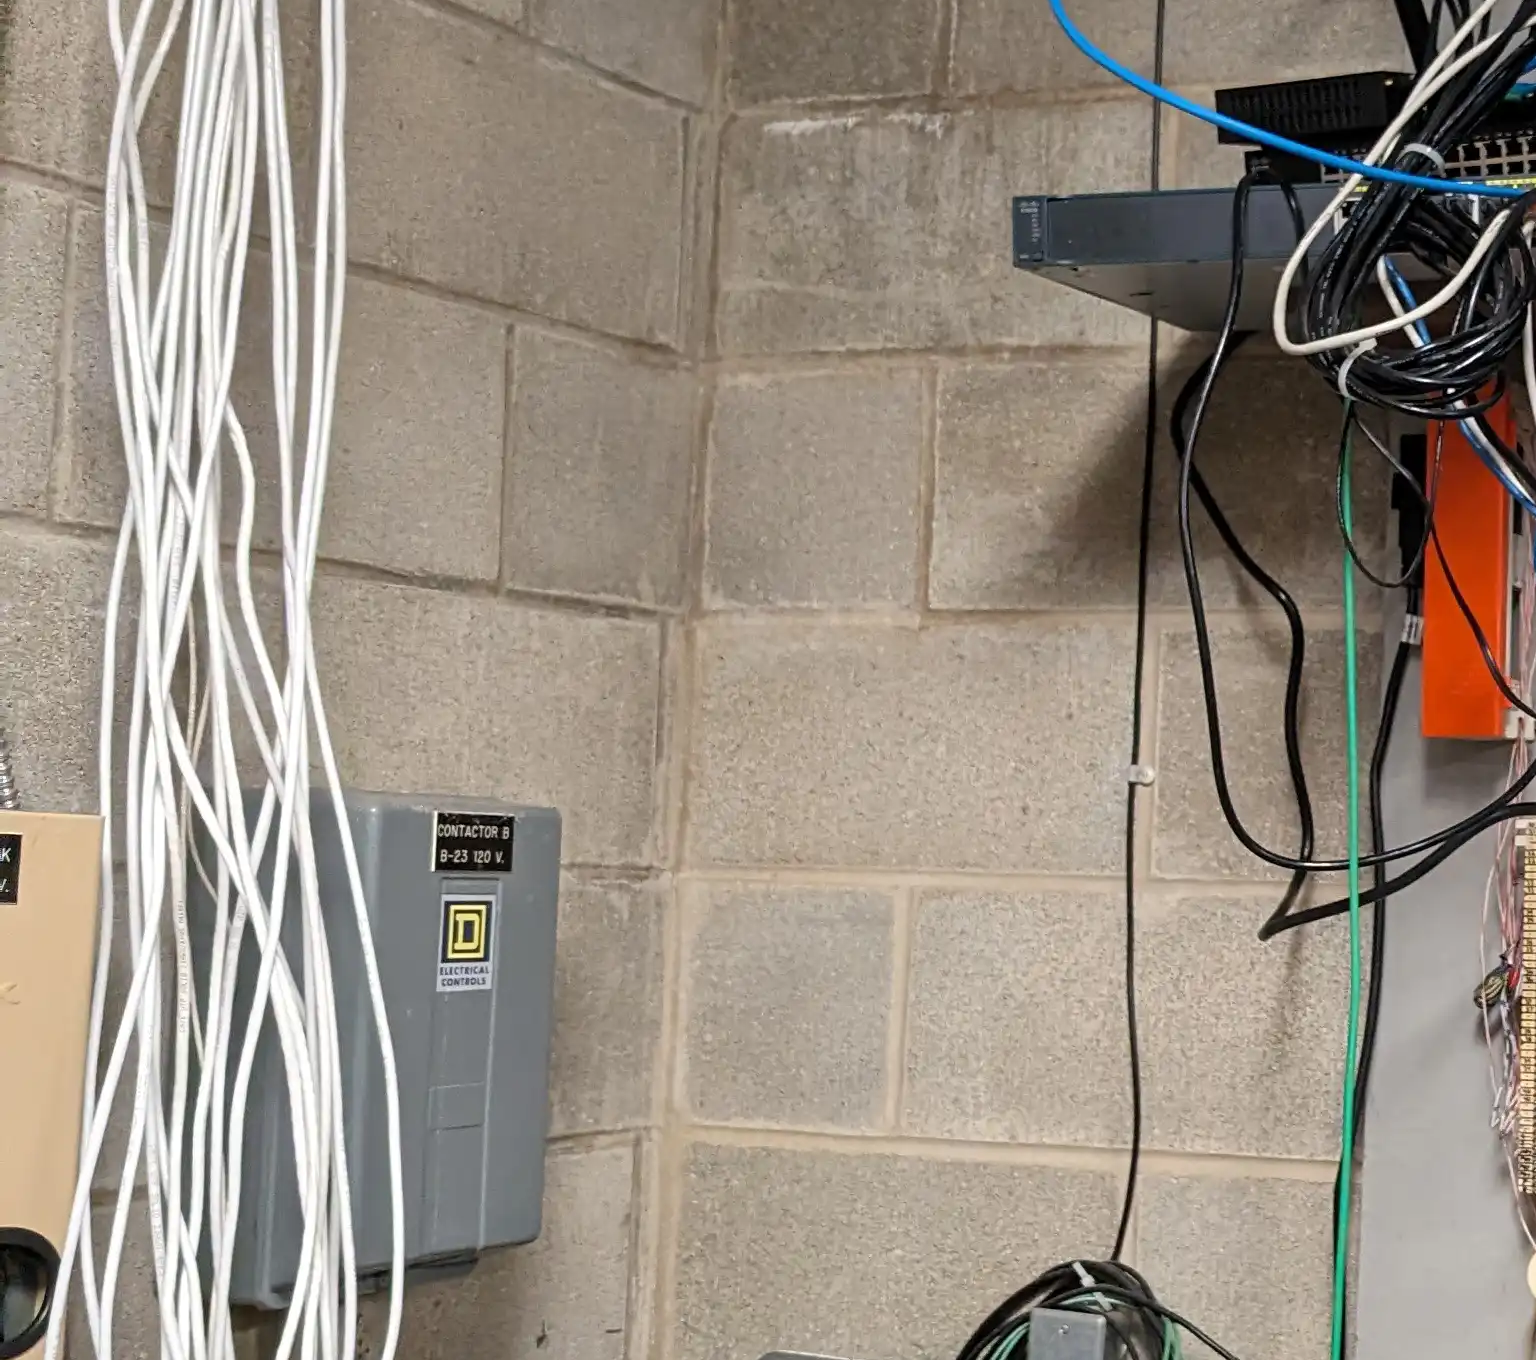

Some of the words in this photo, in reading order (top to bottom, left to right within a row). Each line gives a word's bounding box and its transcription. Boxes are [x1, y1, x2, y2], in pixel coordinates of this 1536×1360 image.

[437, 823, 499, 840] CONTACTOR
[502, 826, 510, 840] B
[440, 848, 468, 864] B-23
[473, 849, 492, 864] 120
[495, 850, 505, 864] V.
[439, 965, 490, 976] ELECTRICAL
[441, 976, 487, 987] CONTROLS
